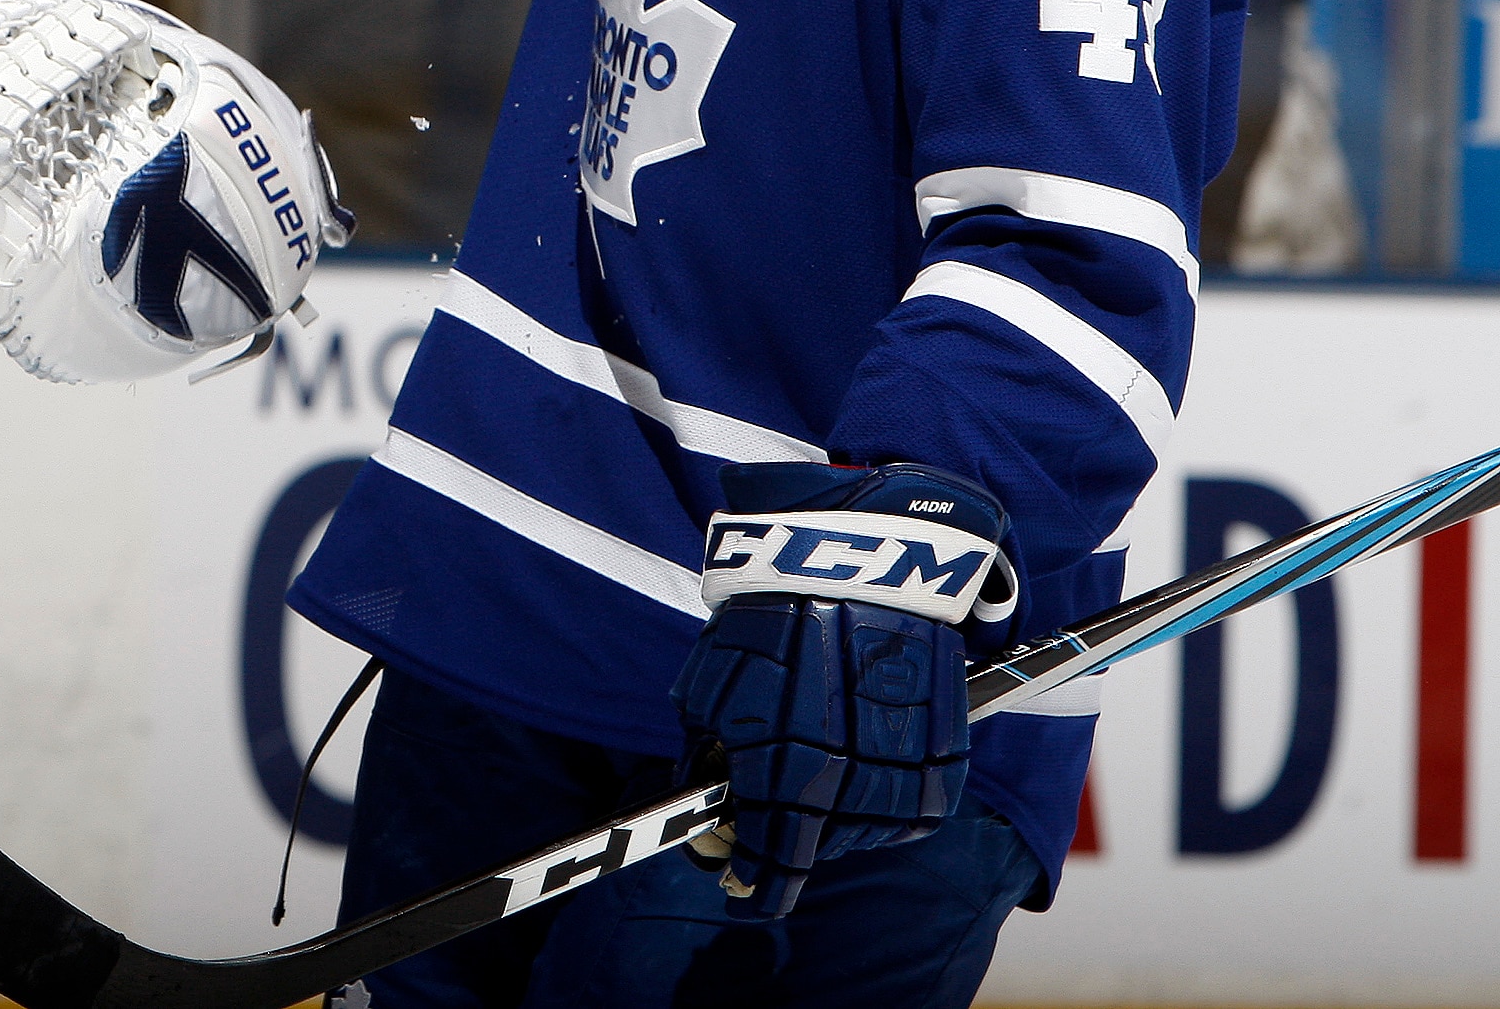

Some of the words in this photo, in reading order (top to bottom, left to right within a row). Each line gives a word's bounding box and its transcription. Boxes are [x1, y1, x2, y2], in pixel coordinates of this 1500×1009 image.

[212, 98, 313, 270] BAUER
[908, 499, 955, 515] KADRI
[705, 521, 989, 599] CCM
